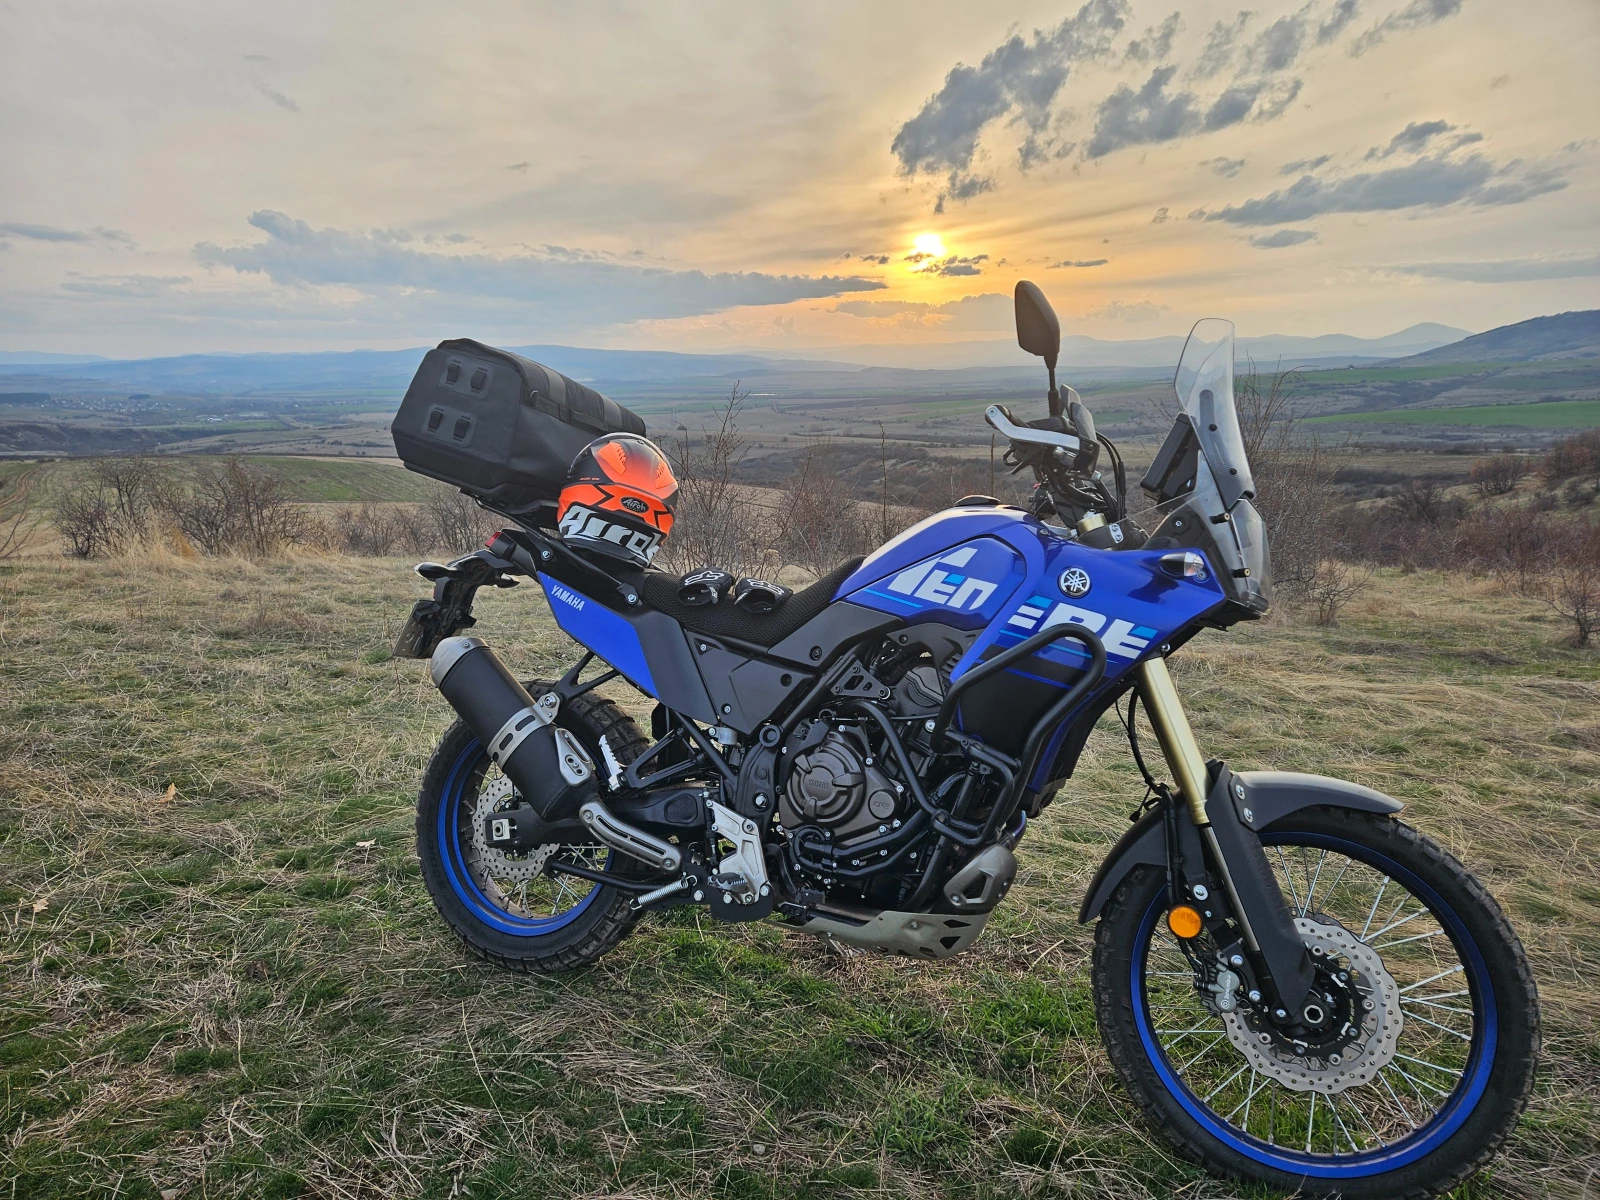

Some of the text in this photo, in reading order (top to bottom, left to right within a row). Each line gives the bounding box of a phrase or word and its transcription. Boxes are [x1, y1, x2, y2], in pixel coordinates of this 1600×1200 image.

[622, 498, 646, 512] Airoh
[551, 584, 585, 611] YAMAHA
[808, 778, 830, 789] YAMAHA
